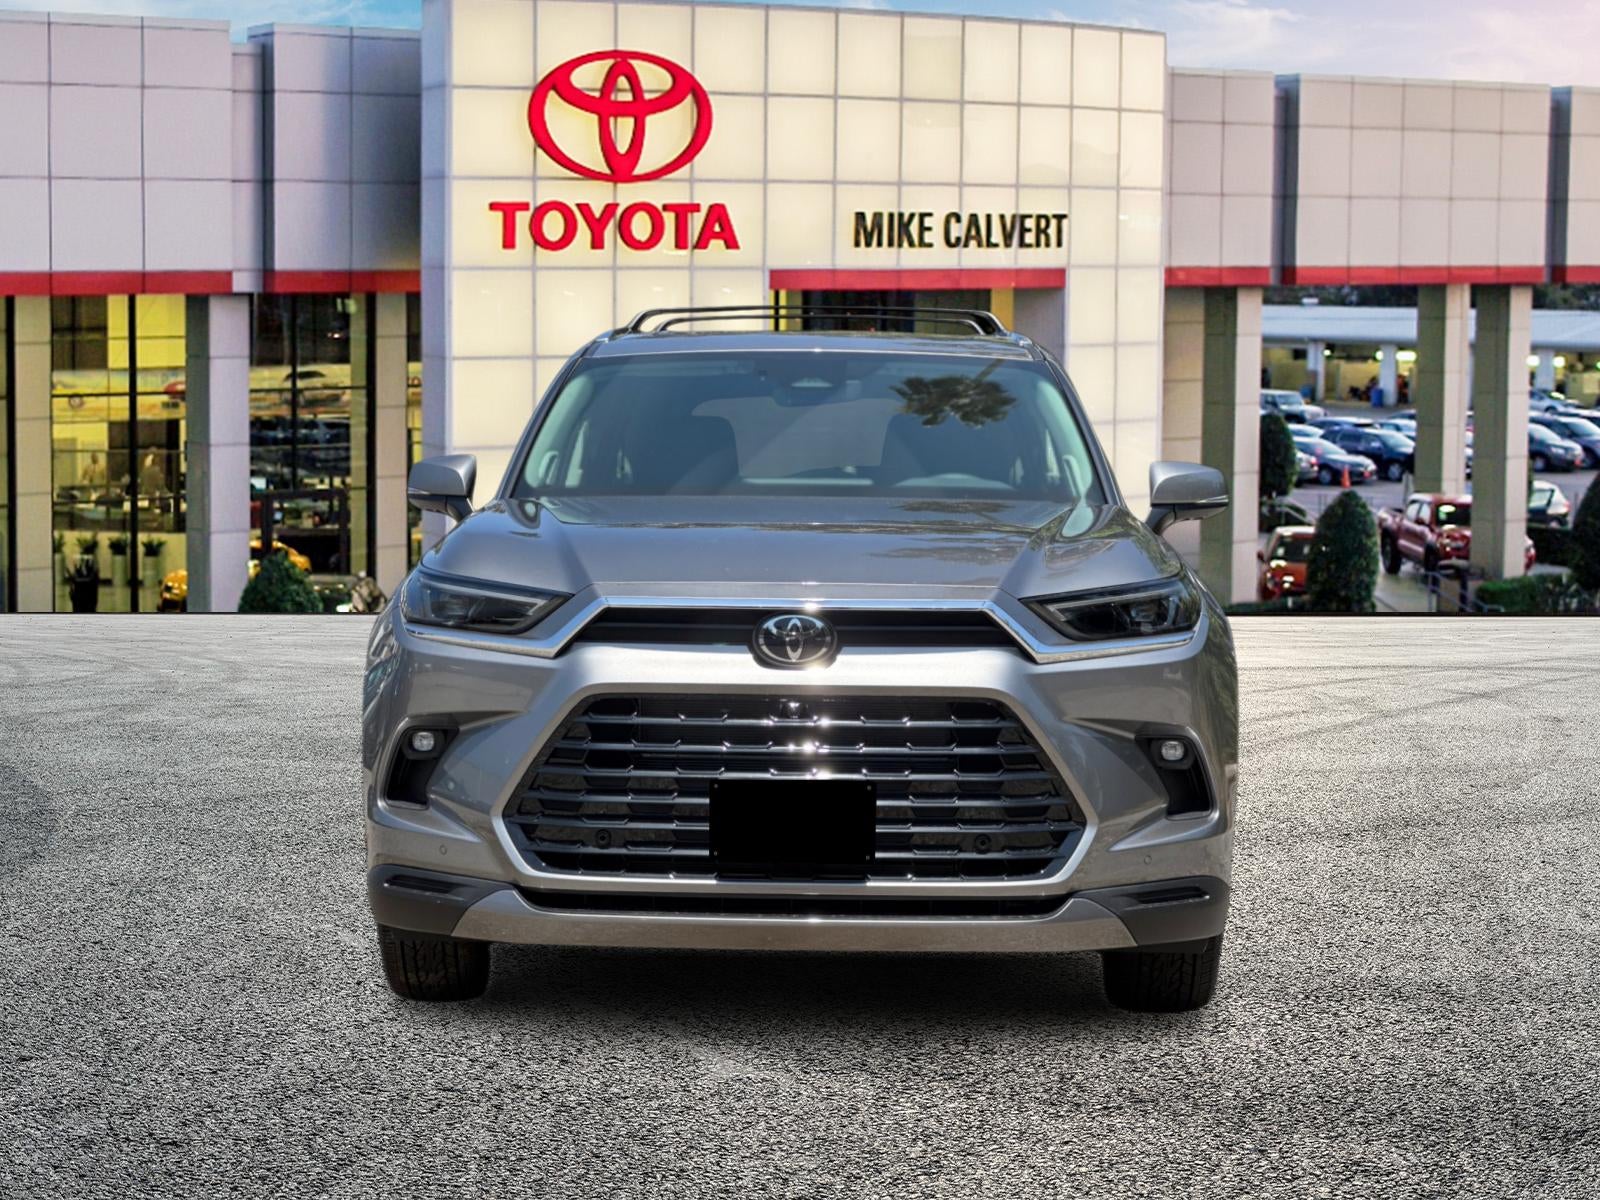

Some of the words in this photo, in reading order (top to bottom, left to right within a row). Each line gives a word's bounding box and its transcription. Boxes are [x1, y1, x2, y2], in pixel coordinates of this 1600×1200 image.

[489, 201, 740, 251] TOYOTA
[854, 211, 934, 248] MIKE
[943, 212, 1069, 249] CALVERT
